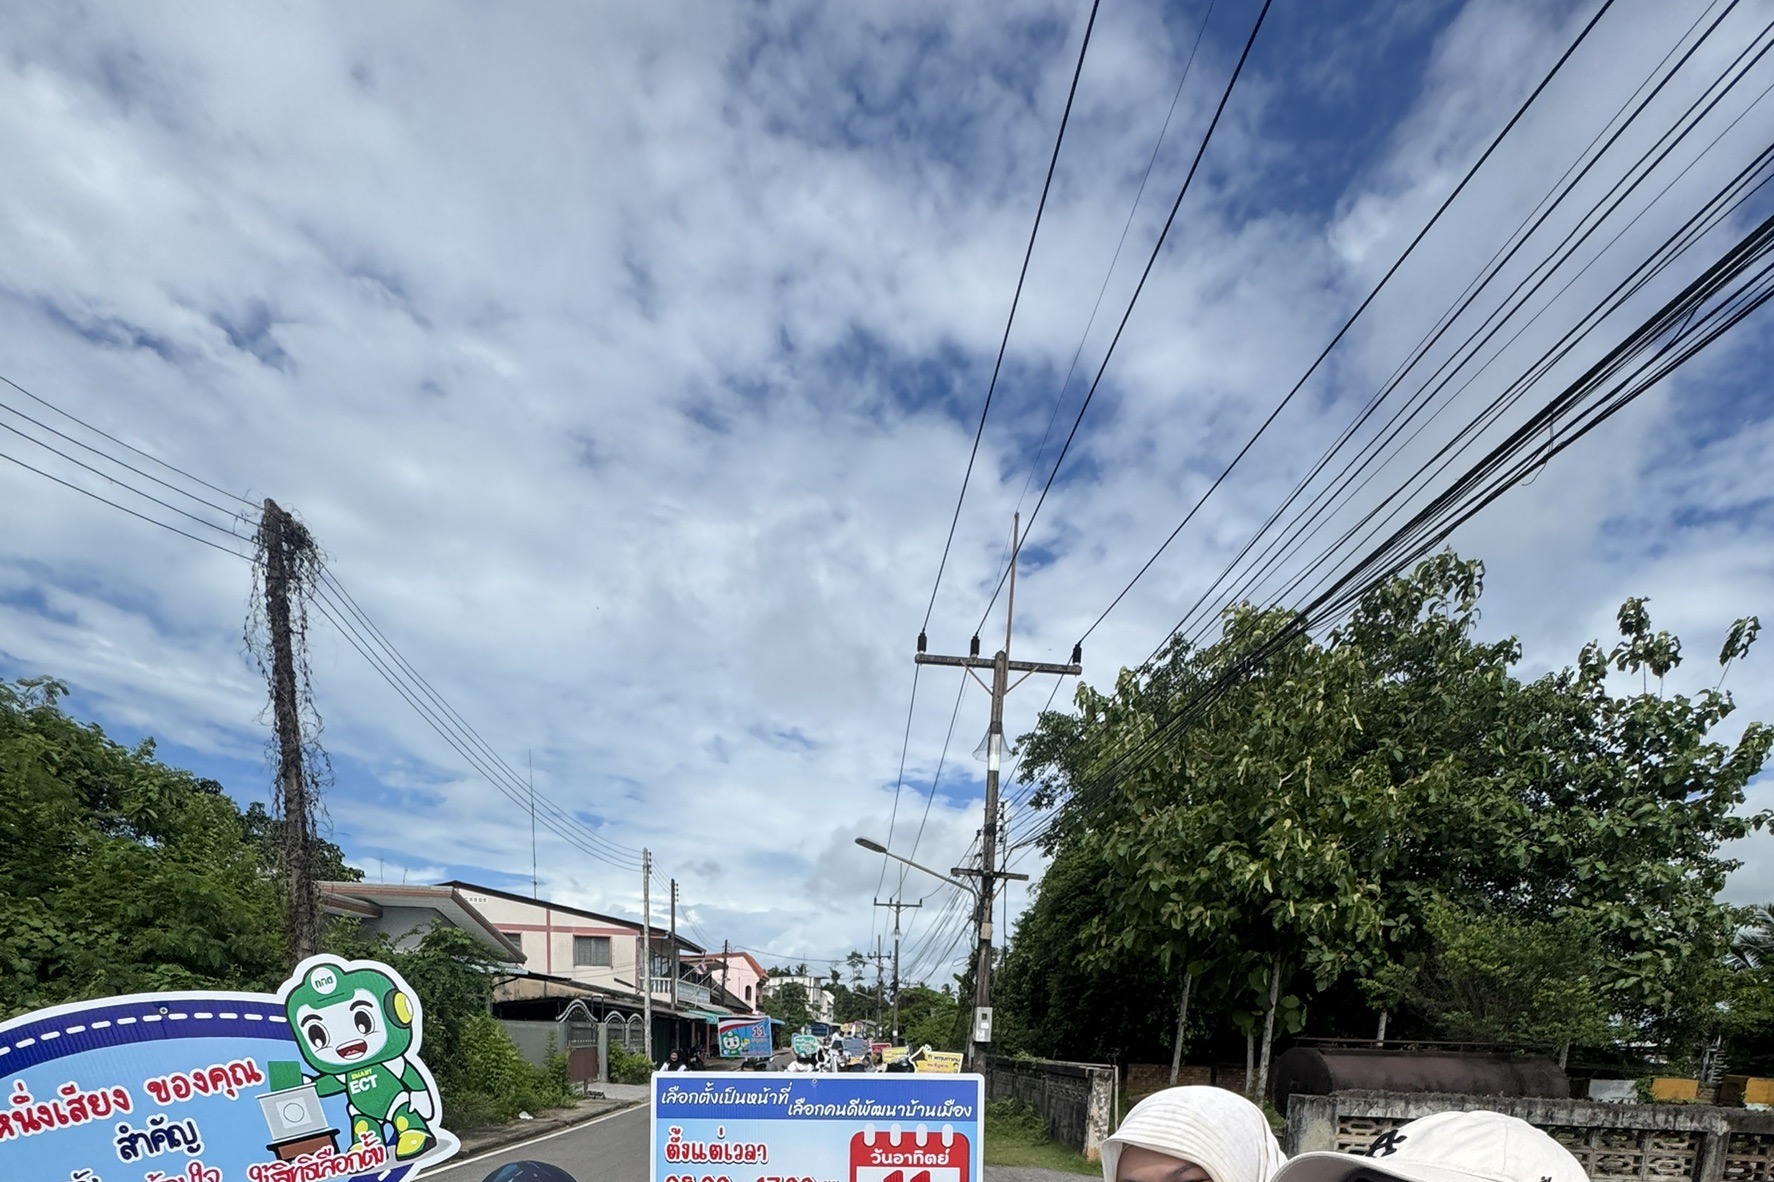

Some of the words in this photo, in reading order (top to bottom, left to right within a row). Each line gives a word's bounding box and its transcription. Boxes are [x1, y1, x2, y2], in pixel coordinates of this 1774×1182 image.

[147, 1060, 262, 1103] ของคุณ
[350, 1075, 378, 1095] ECT
[660, 1081, 792, 1105] เลือกตั้งเป็นหน้าที่
[787, 1097, 972, 1119] เลือกคนดีพัฒนาบ้านเมือง
[117, 1117, 201, 1160] สำคัญ
[665, 1126, 768, 1164] ตั้งแต่เวลา
[870, 1148, 950, 1166] วันอาทิตย์
